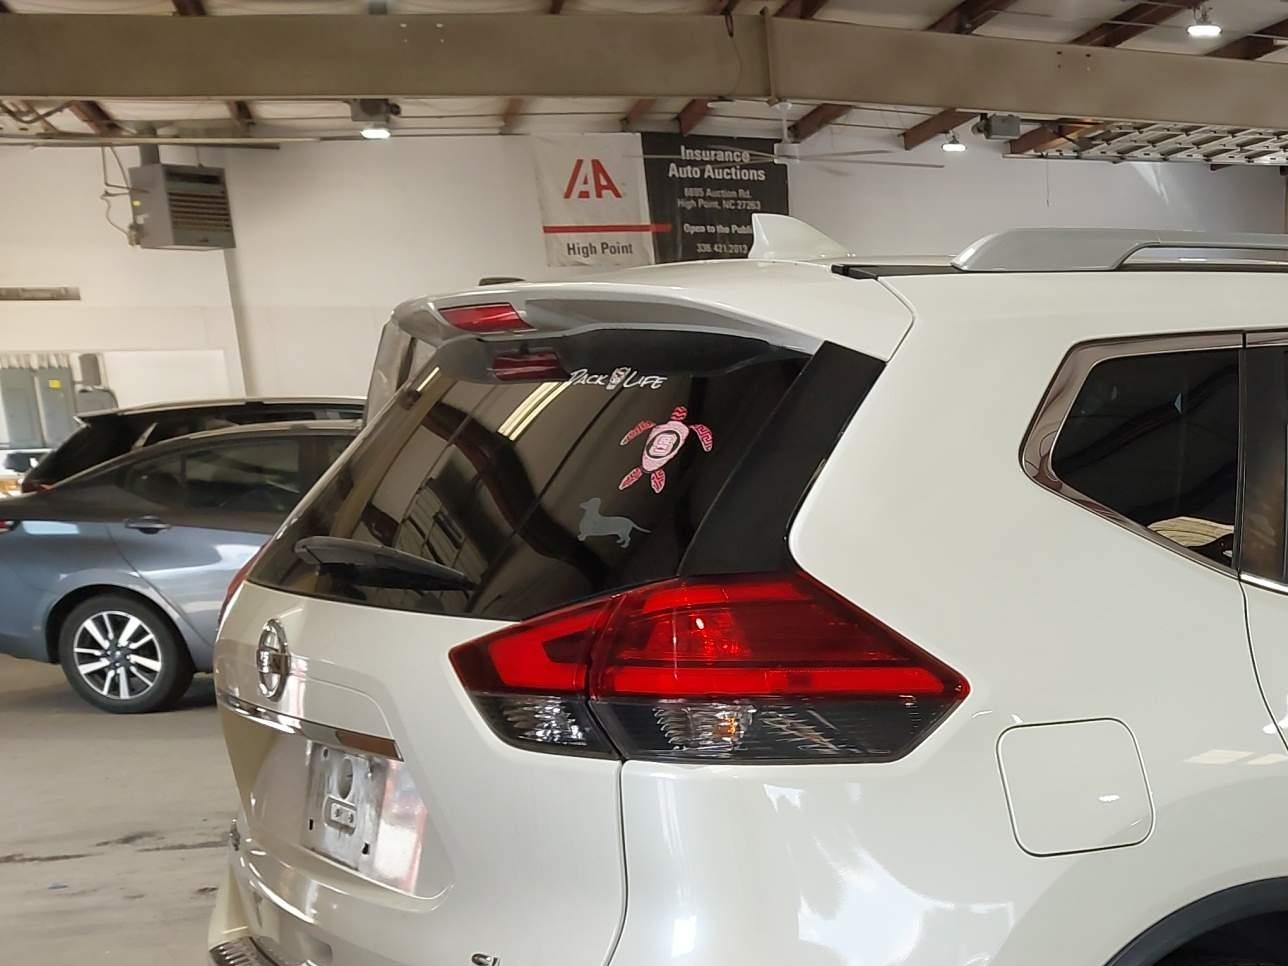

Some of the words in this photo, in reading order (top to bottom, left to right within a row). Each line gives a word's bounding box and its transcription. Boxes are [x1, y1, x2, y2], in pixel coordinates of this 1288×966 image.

[681, 145, 751, 162] Insurance
[668, 162, 700, 178] Auto
[704, 165, 766, 181] Auctions
[678, 199, 697, 210] High
[722, 201, 735, 209] NC
[683, 223, 706, 235] Open
[706, 225, 716, 233] to
[717, 225, 730, 234] the
[731, 225, 753, 234] Publi
[567, 242, 597, 258] High
[601, 242, 633, 256] Point
